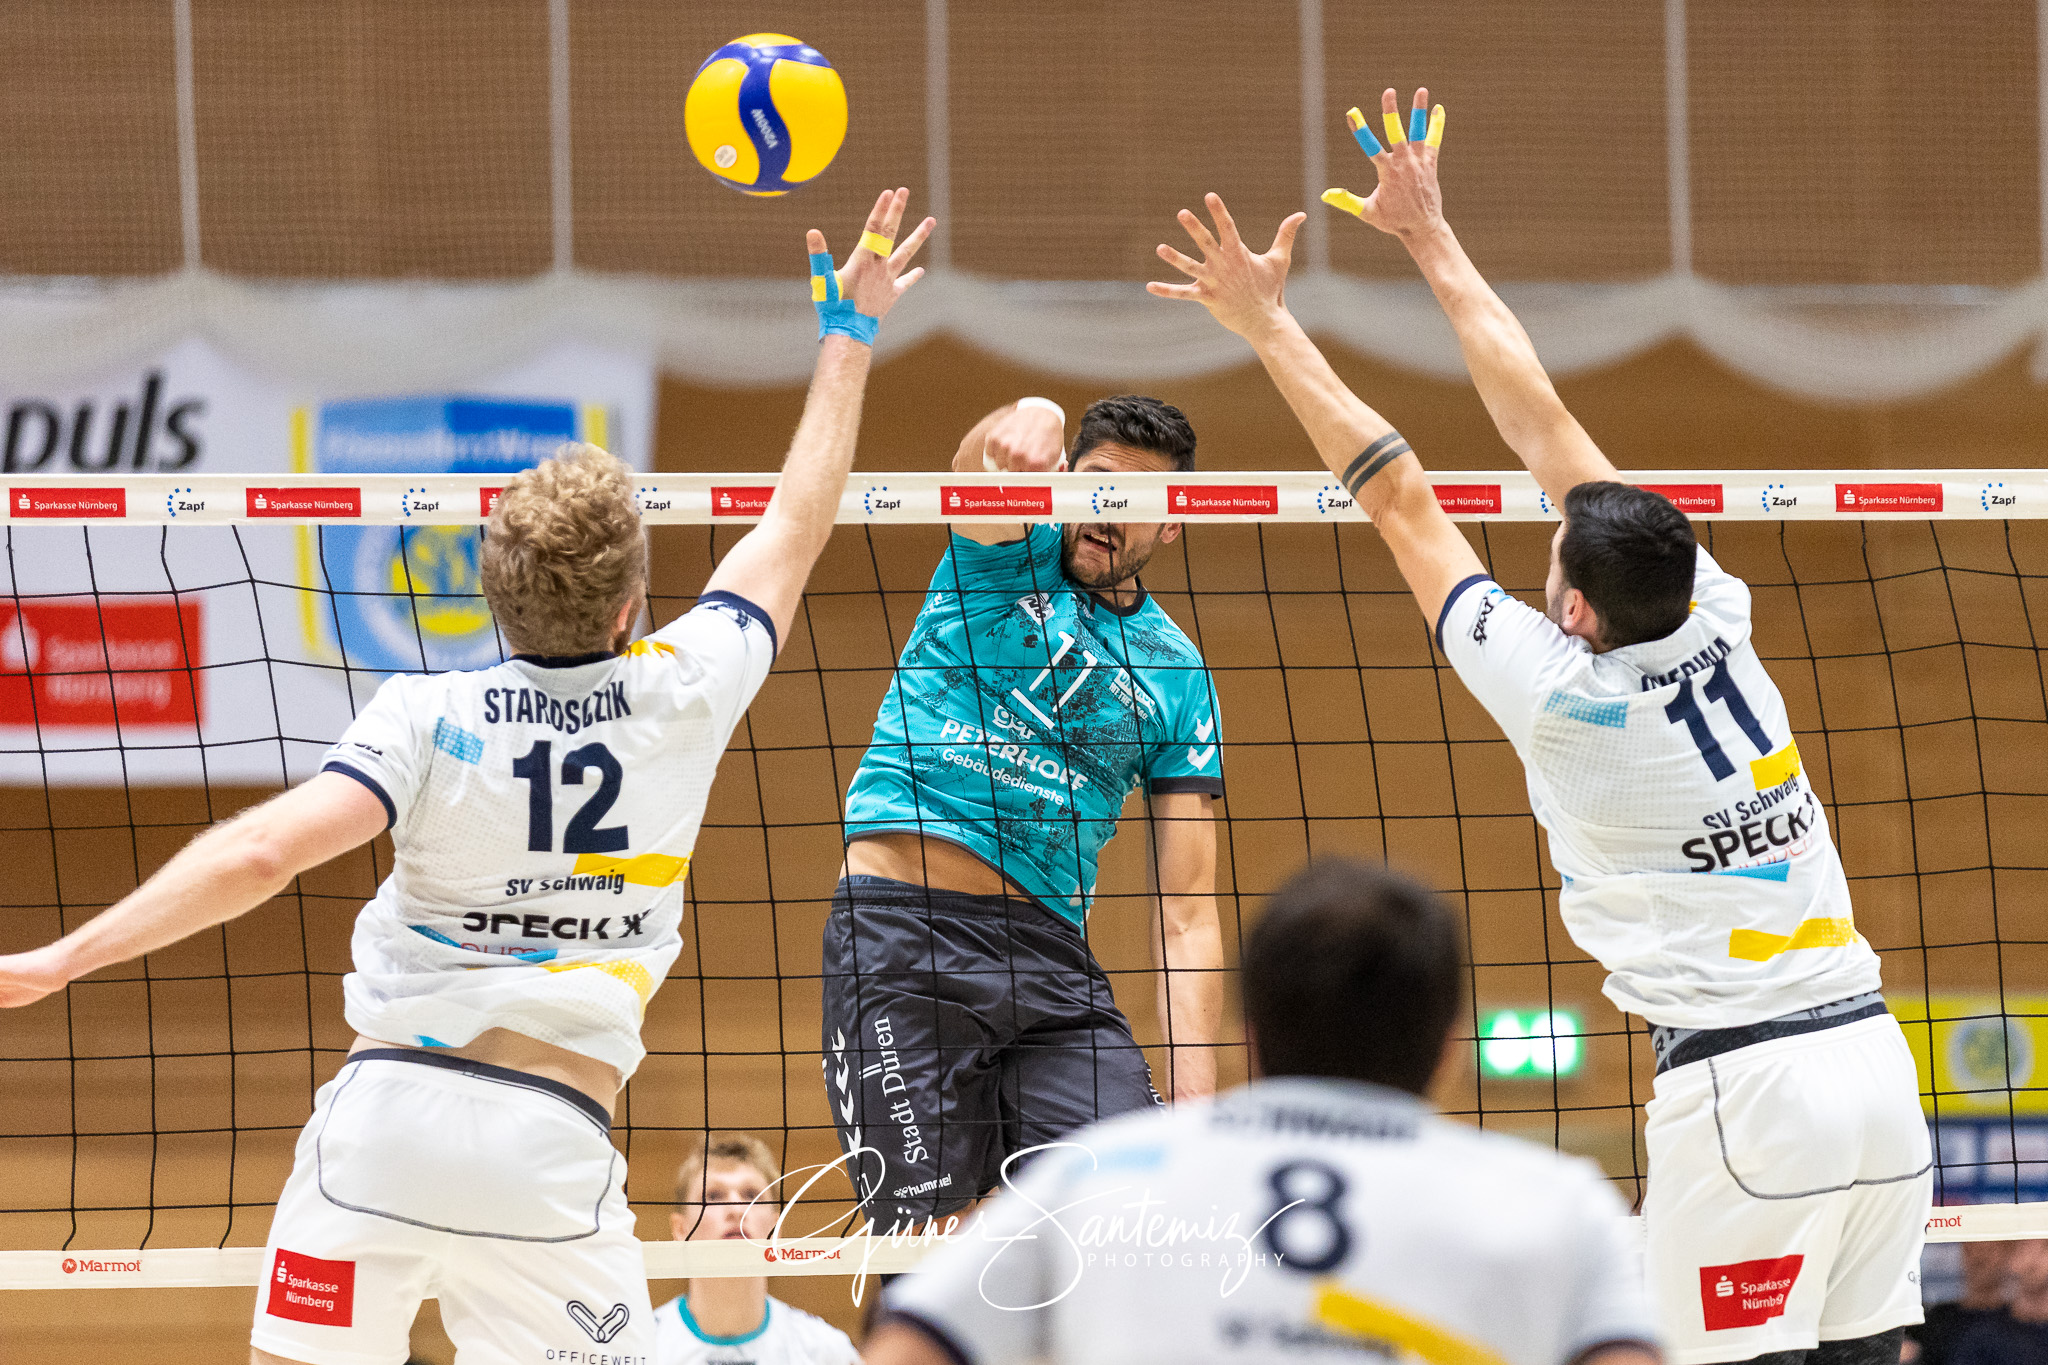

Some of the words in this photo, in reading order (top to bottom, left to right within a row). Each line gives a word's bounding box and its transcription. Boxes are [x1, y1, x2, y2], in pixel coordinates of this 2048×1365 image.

[34, 501, 76, 512] Sparkasse
[78, 500, 118, 511] Nürnberg
[178, 501, 205, 512] Zapf
[270, 500, 312, 511] Sparkasse
[314, 499, 354, 511] Nürnberg
[413, 500, 440, 512] Zapf
[645, 500, 672, 511] Zapf
[875, 499, 901, 510] Zapf
[964, 498, 1005, 509] Sparkasse
[1006, 497, 1045, 508] Nürnberg
[1102, 498, 1128, 509] Zapf
[1191, 497, 1231, 508] Sparkasse
[1233, 496, 1271, 507] Nürnberg
[1327, 498, 1353, 509] Zapf
[1457, 497, 1494, 507] Nürnberg
[1680, 496, 1716, 507] Nürnberg
[1772, 496, 1797, 507] Zapf
[1858, 495, 1898, 506] Sparkasse
[1899, 495, 1936, 505] Nürnberg
[1991, 495, 2016, 506] Zapf
[1664, 657, 1774, 782] 11
[939, 718, 1089, 791] PETERHOFF
[942, 748, 1065, 806] Gebäudedienste
[512, 740, 630, 854] 12
[1702, 808, 1733, 830] SV
[1735, 771, 1800, 822] Schwaig
[1681, 805, 1810, 873] SPECK
[505, 878, 534, 897] SV
[889, 1097, 930, 1165] Stadt
[1264, 1158, 1356, 1275] 8
[79, 1260, 141, 1272] Marmot
[287, 1274, 339, 1293] Sparkasse
[285, 1290, 334, 1312] Nürnberg
